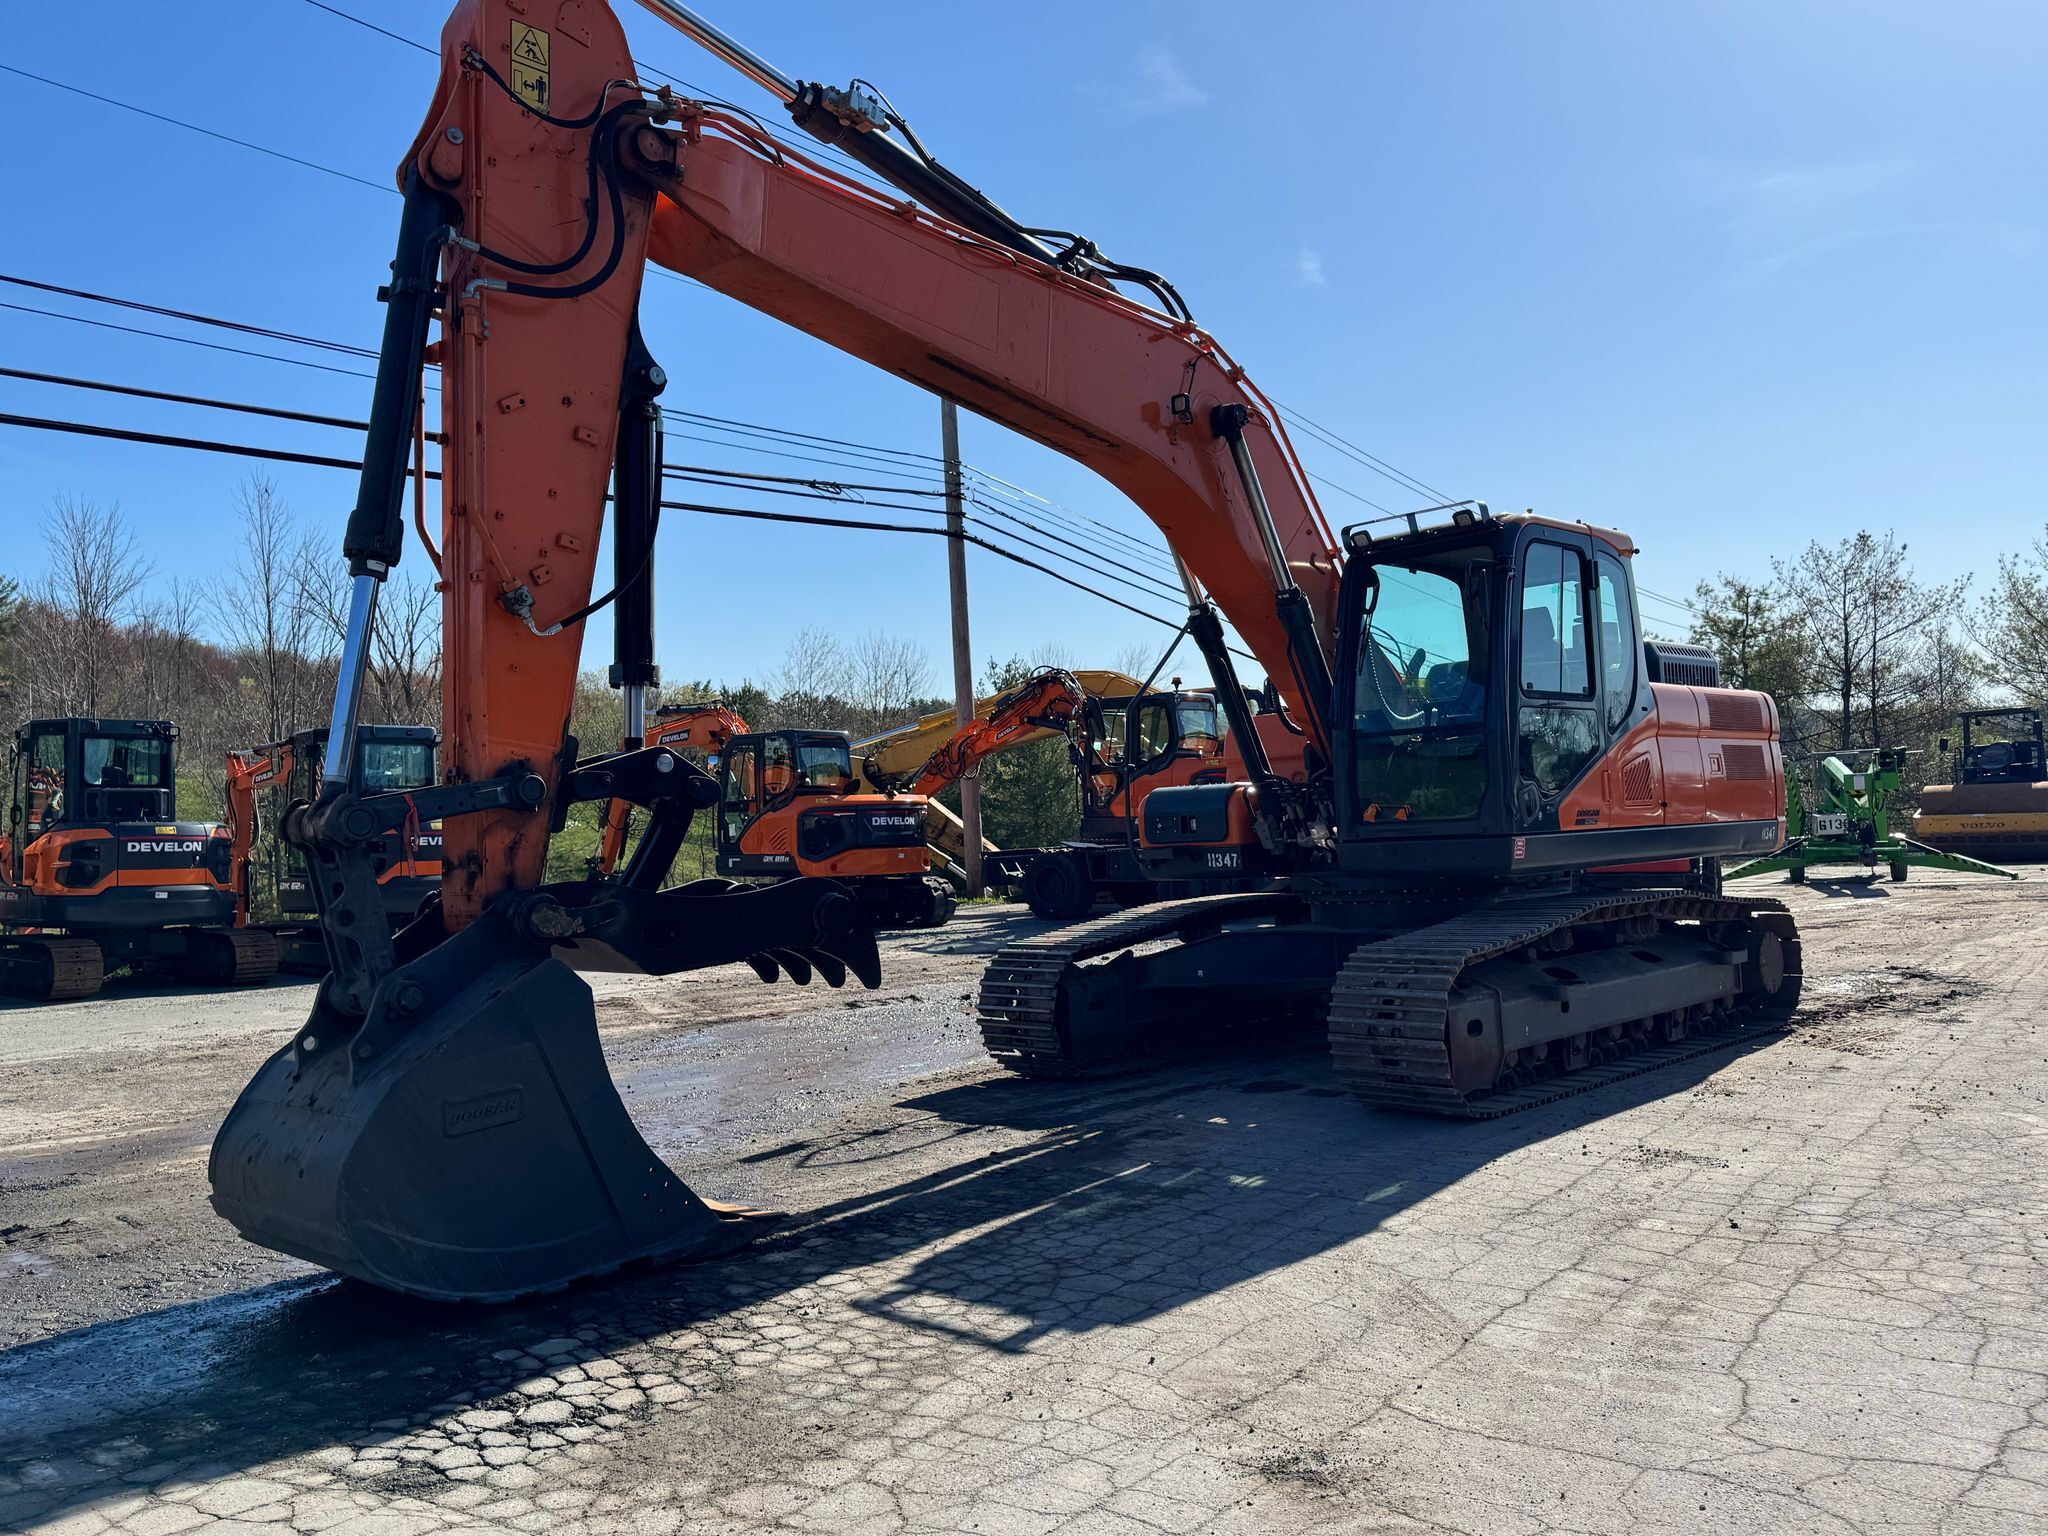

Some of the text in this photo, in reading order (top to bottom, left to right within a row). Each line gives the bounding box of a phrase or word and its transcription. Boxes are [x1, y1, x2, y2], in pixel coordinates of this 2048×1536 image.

[662, 732, 689, 743] DEVELON
[872, 816, 915, 826] DEVELON
[127, 842, 202, 852] DEVELON
[1207, 853, 1238, 868] 11347
